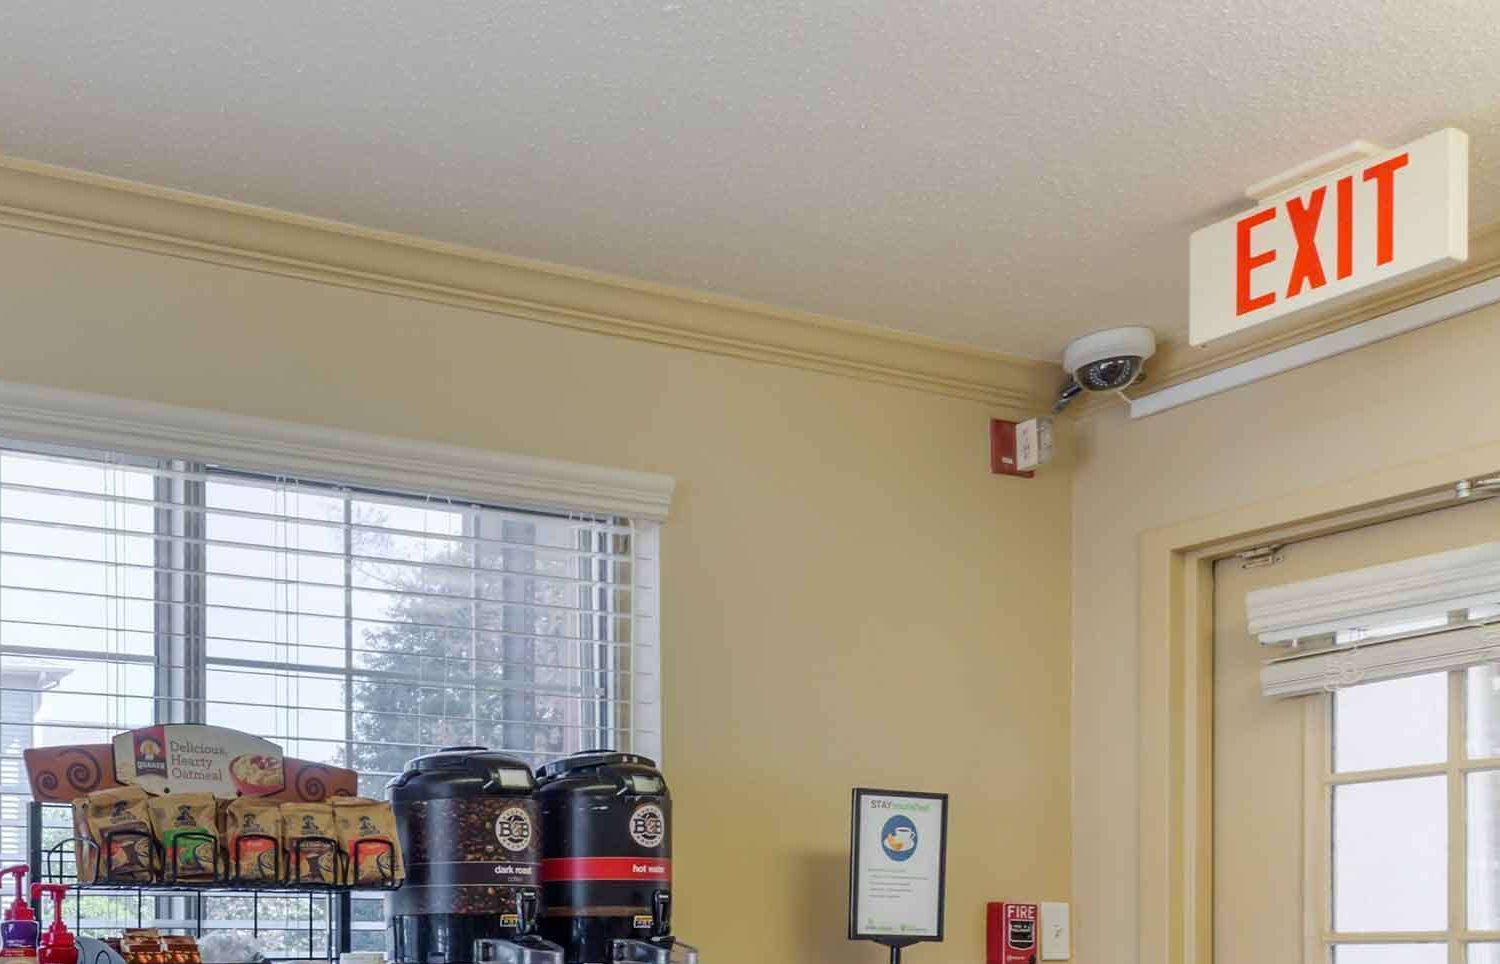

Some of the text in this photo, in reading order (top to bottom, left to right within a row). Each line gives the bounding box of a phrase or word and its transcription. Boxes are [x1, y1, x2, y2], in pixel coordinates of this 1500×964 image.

[1235, 152, 1409, 317] EXIT
[171, 754, 213, 769] Hearty
[171, 768, 223, 781] Oatmeal
[494, 865, 514, 874] dark
[632, 863, 647, 873] hot
[1007, 905, 1036, 919] FIRE
